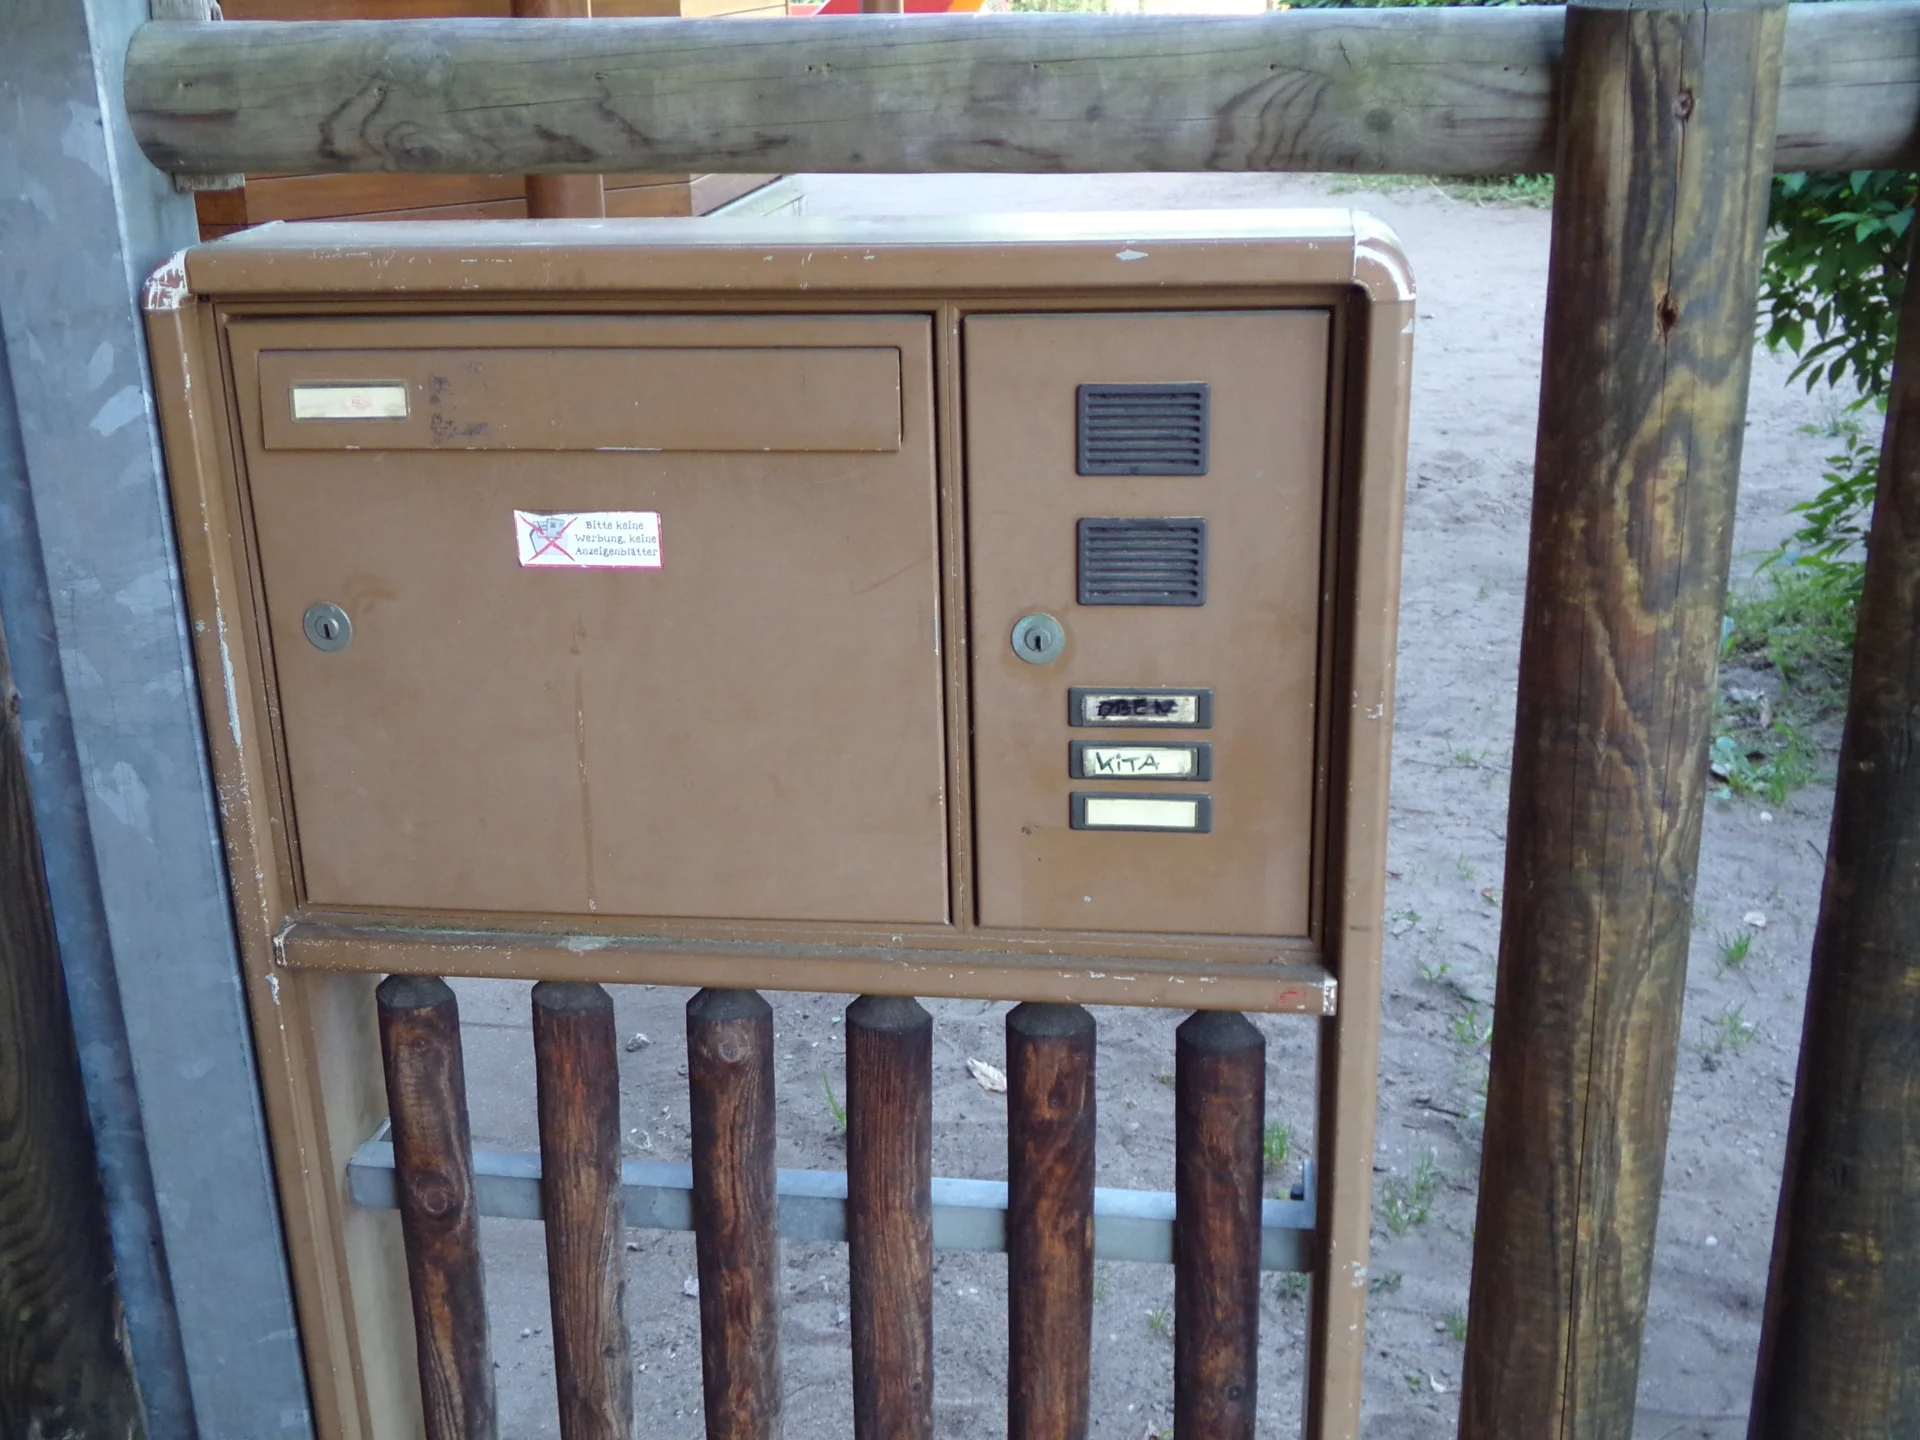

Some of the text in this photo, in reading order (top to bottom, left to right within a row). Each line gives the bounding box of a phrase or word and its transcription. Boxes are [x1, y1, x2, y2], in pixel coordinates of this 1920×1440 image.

[585, 520, 644, 530] Bitte keine
[629, 534, 657, 544] keine
[575, 546, 659, 557] Anzeigenblätter
